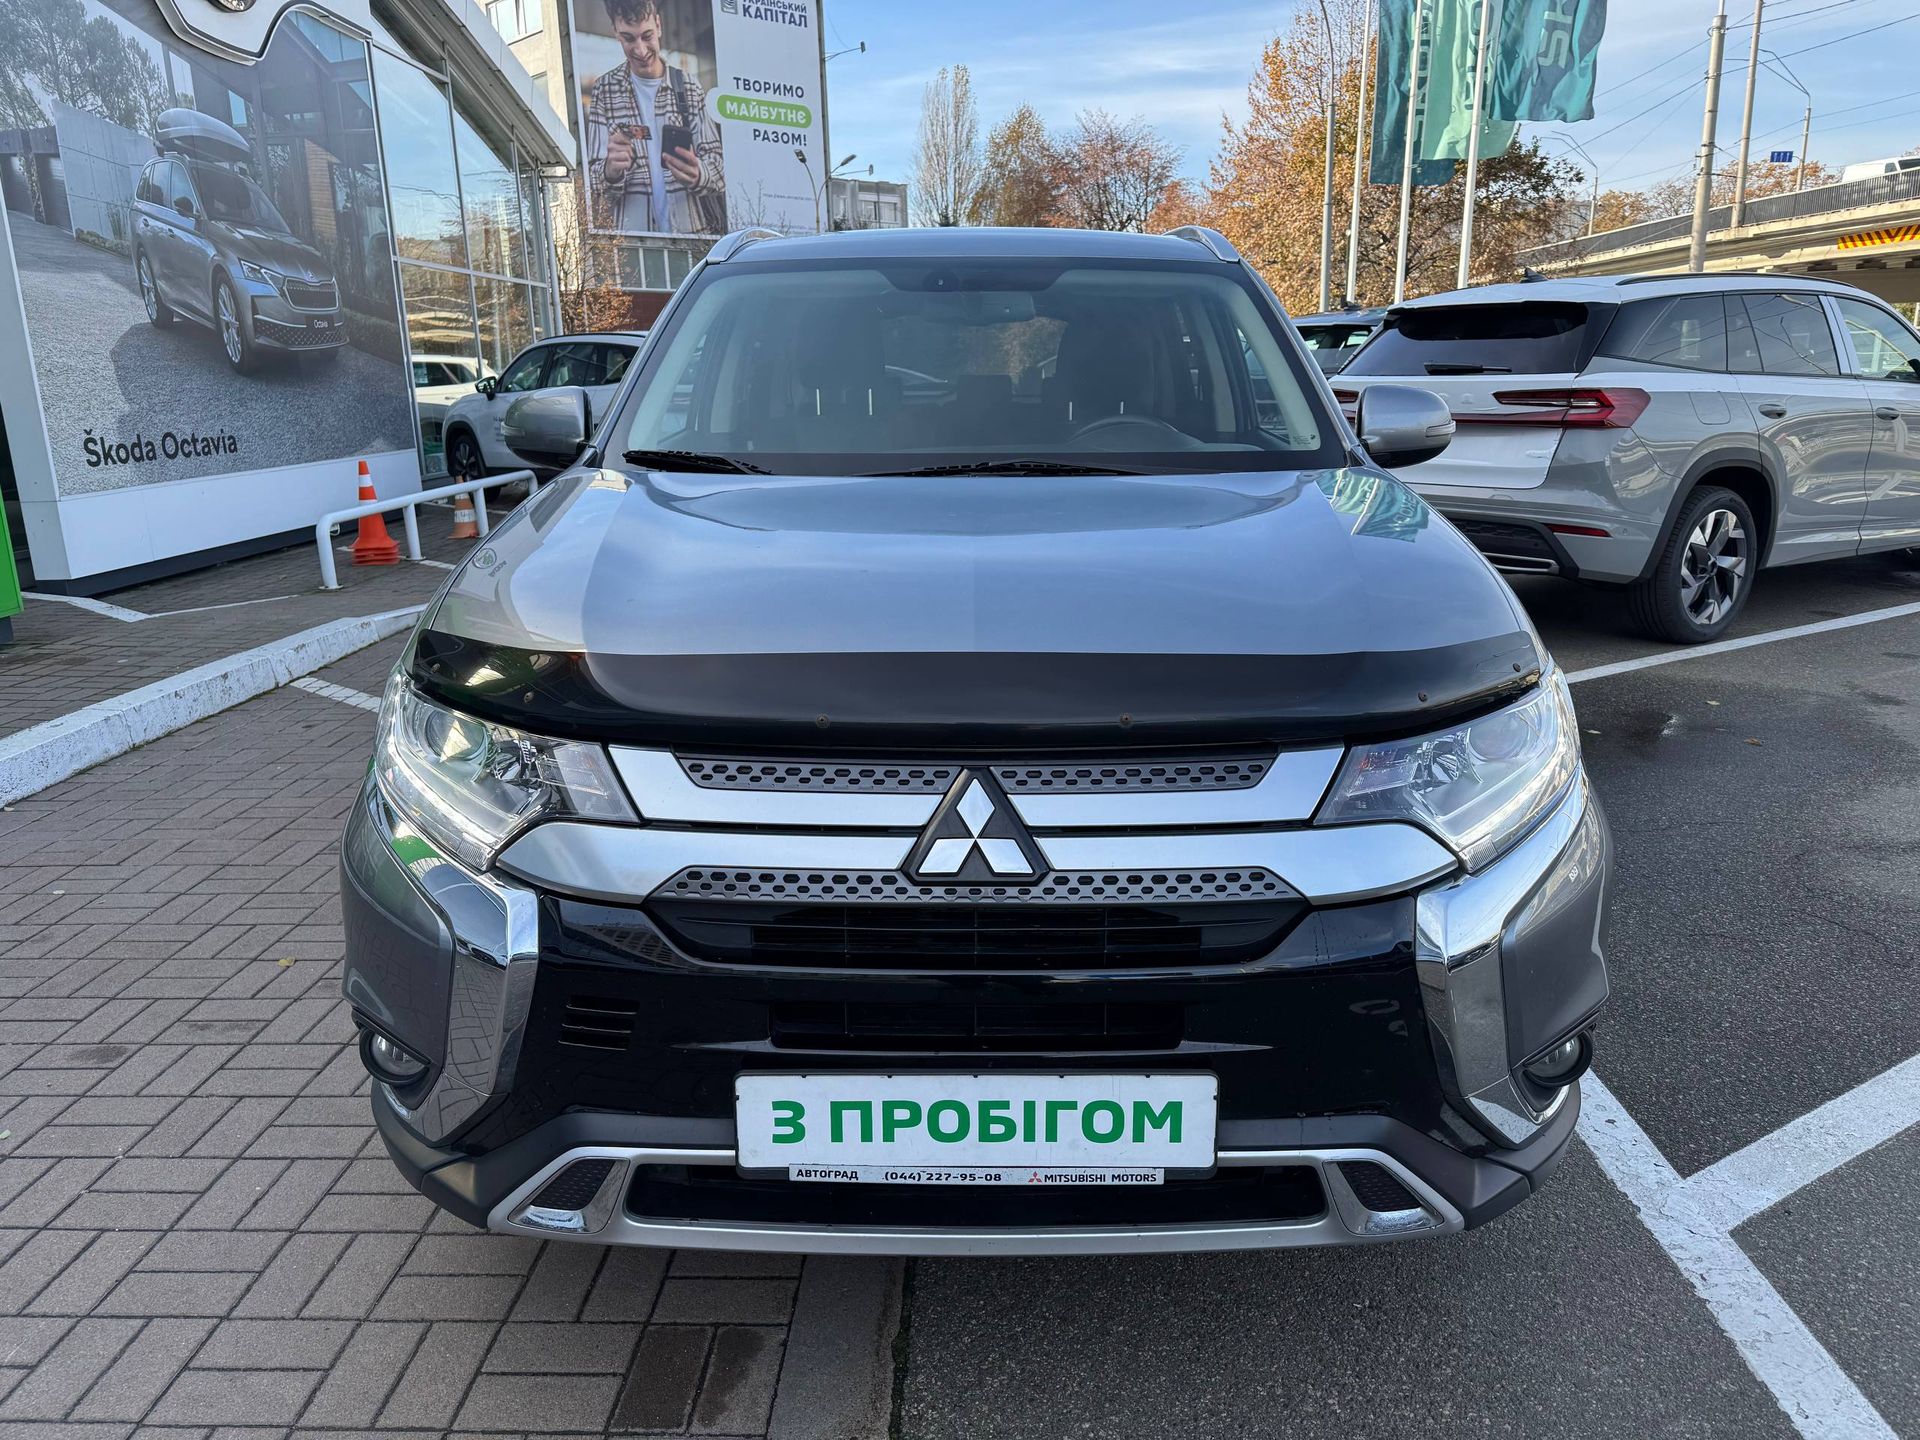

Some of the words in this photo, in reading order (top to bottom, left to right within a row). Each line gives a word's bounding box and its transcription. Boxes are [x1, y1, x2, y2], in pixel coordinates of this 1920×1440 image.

[742, 4, 808, 28] КАПІТАЛ
[733, 76, 804, 98] ТВОРИМО
[726, 101, 806, 124] МАЙБУТНЄ
[753, 128, 807, 147] РАЗОМ!
[83, 428, 157, 468] Škoda
[161, 428, 238, 460] Octavia
[829, 1099, 1183, 1144] ПРОБІГОМ
[796, 1168, 859, 1181] АВТОГРАД
[884, 1171, 922, 1182] (044)
[925, 1172, 1002, 1182] 227-95-08
[1044, 1173, 1106, 1183] MITSUBISHI
[1111, 1173, 1157, 1183] MOTORS
